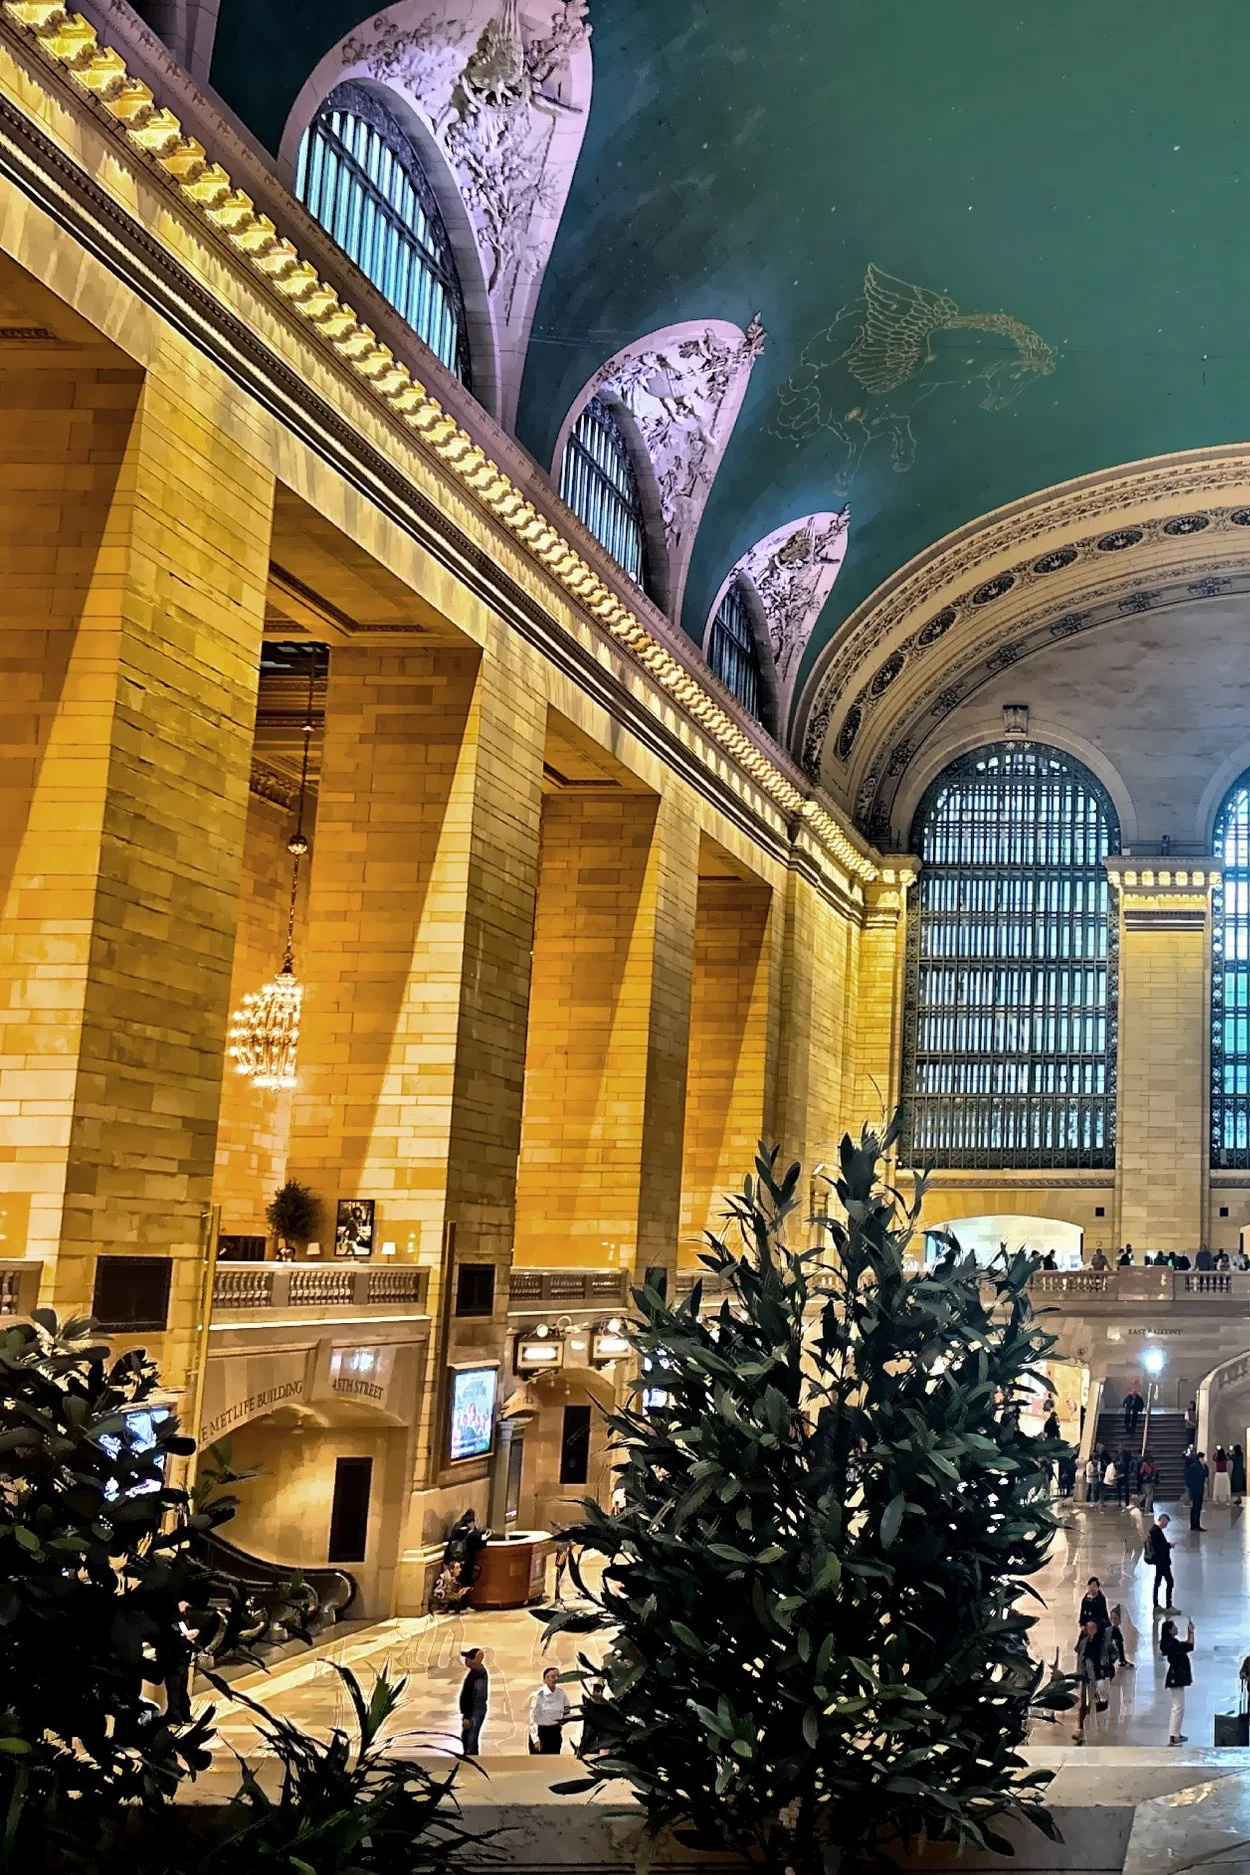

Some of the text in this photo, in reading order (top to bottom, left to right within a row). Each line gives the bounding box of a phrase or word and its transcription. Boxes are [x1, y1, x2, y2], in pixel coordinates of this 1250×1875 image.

[210, 1396, 256, 1436] METLIFE
[257, 1380, 303, 1409] BUILDING
[332, 1378, 384, 1400] 45TH STREET
